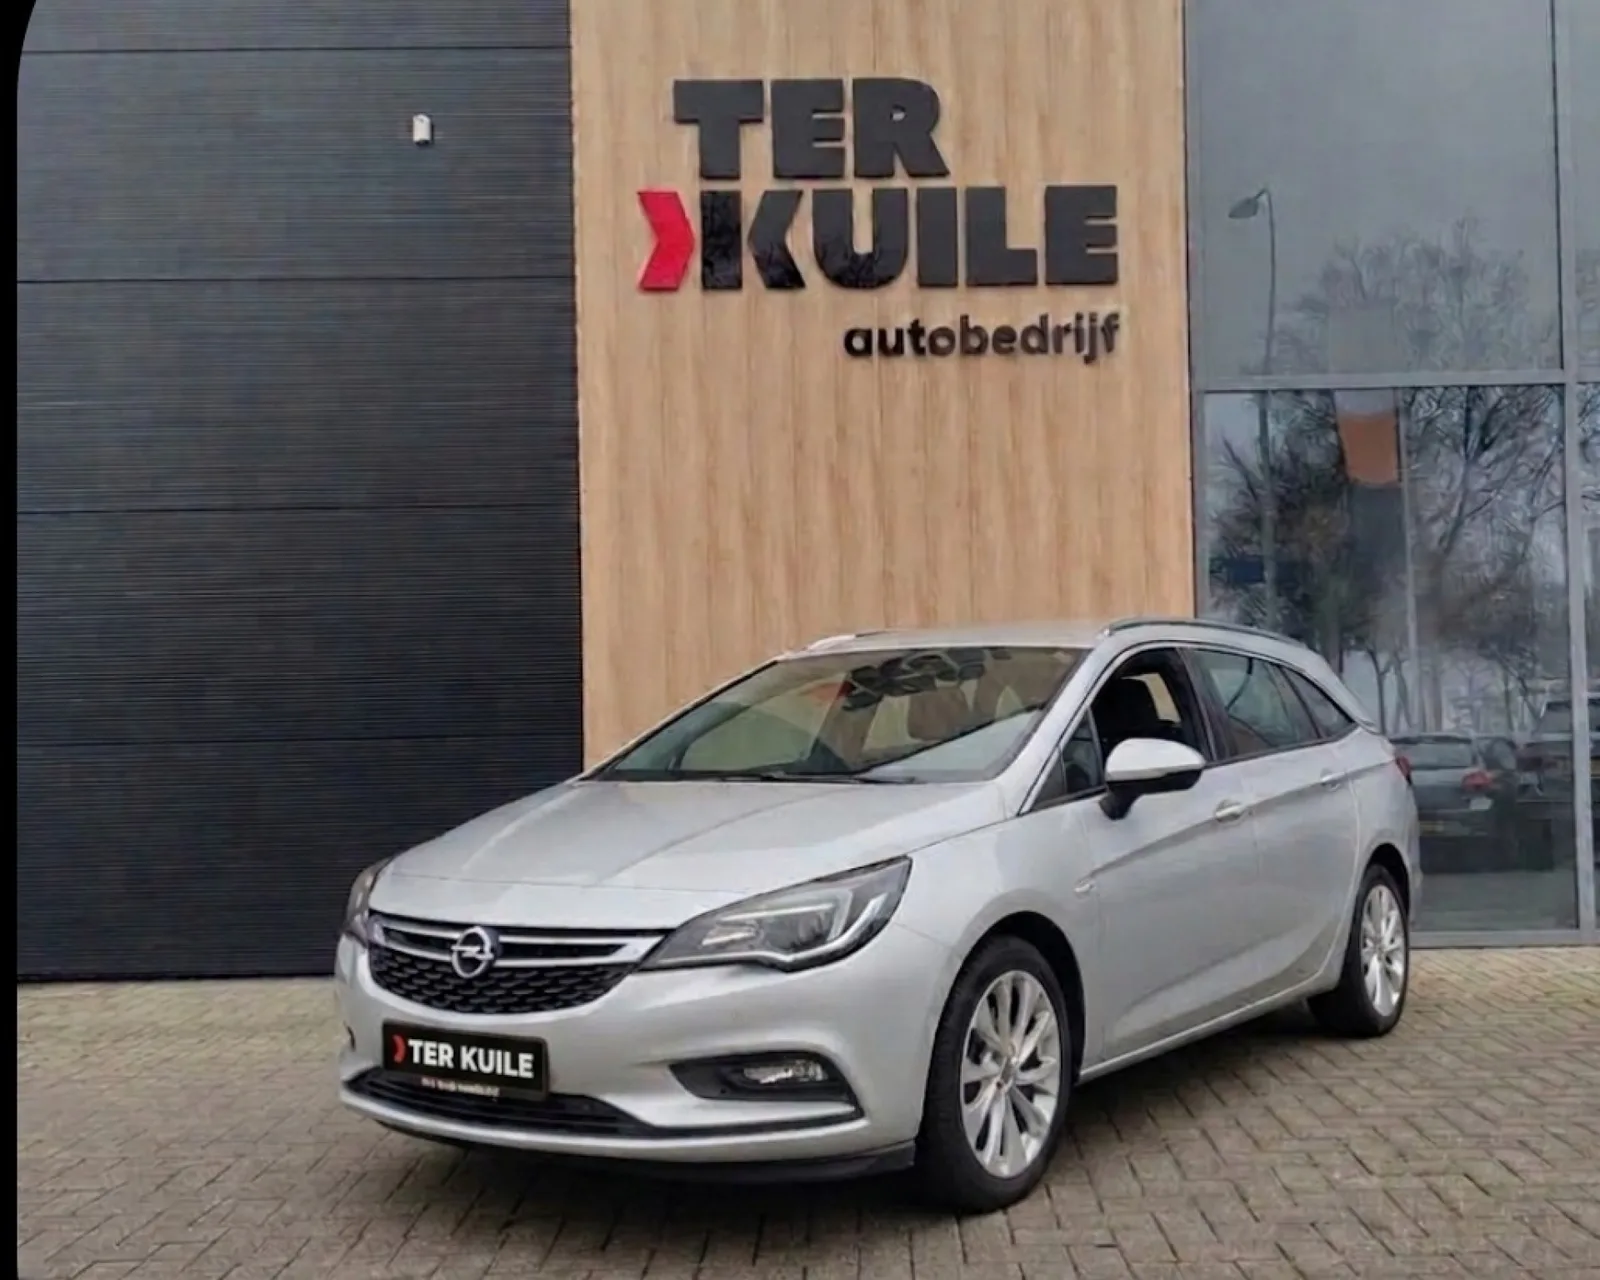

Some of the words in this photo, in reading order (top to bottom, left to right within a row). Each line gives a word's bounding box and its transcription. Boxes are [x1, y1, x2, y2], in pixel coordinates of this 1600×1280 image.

[673, 78, 950, 180] TER
[700, 185, 1118, 290] KUILE
[844, 311, 1120, 364] autobedrijf
[408, 1039, 454, 1068] TER
[460, 1046, 534, 1078] KUILE
